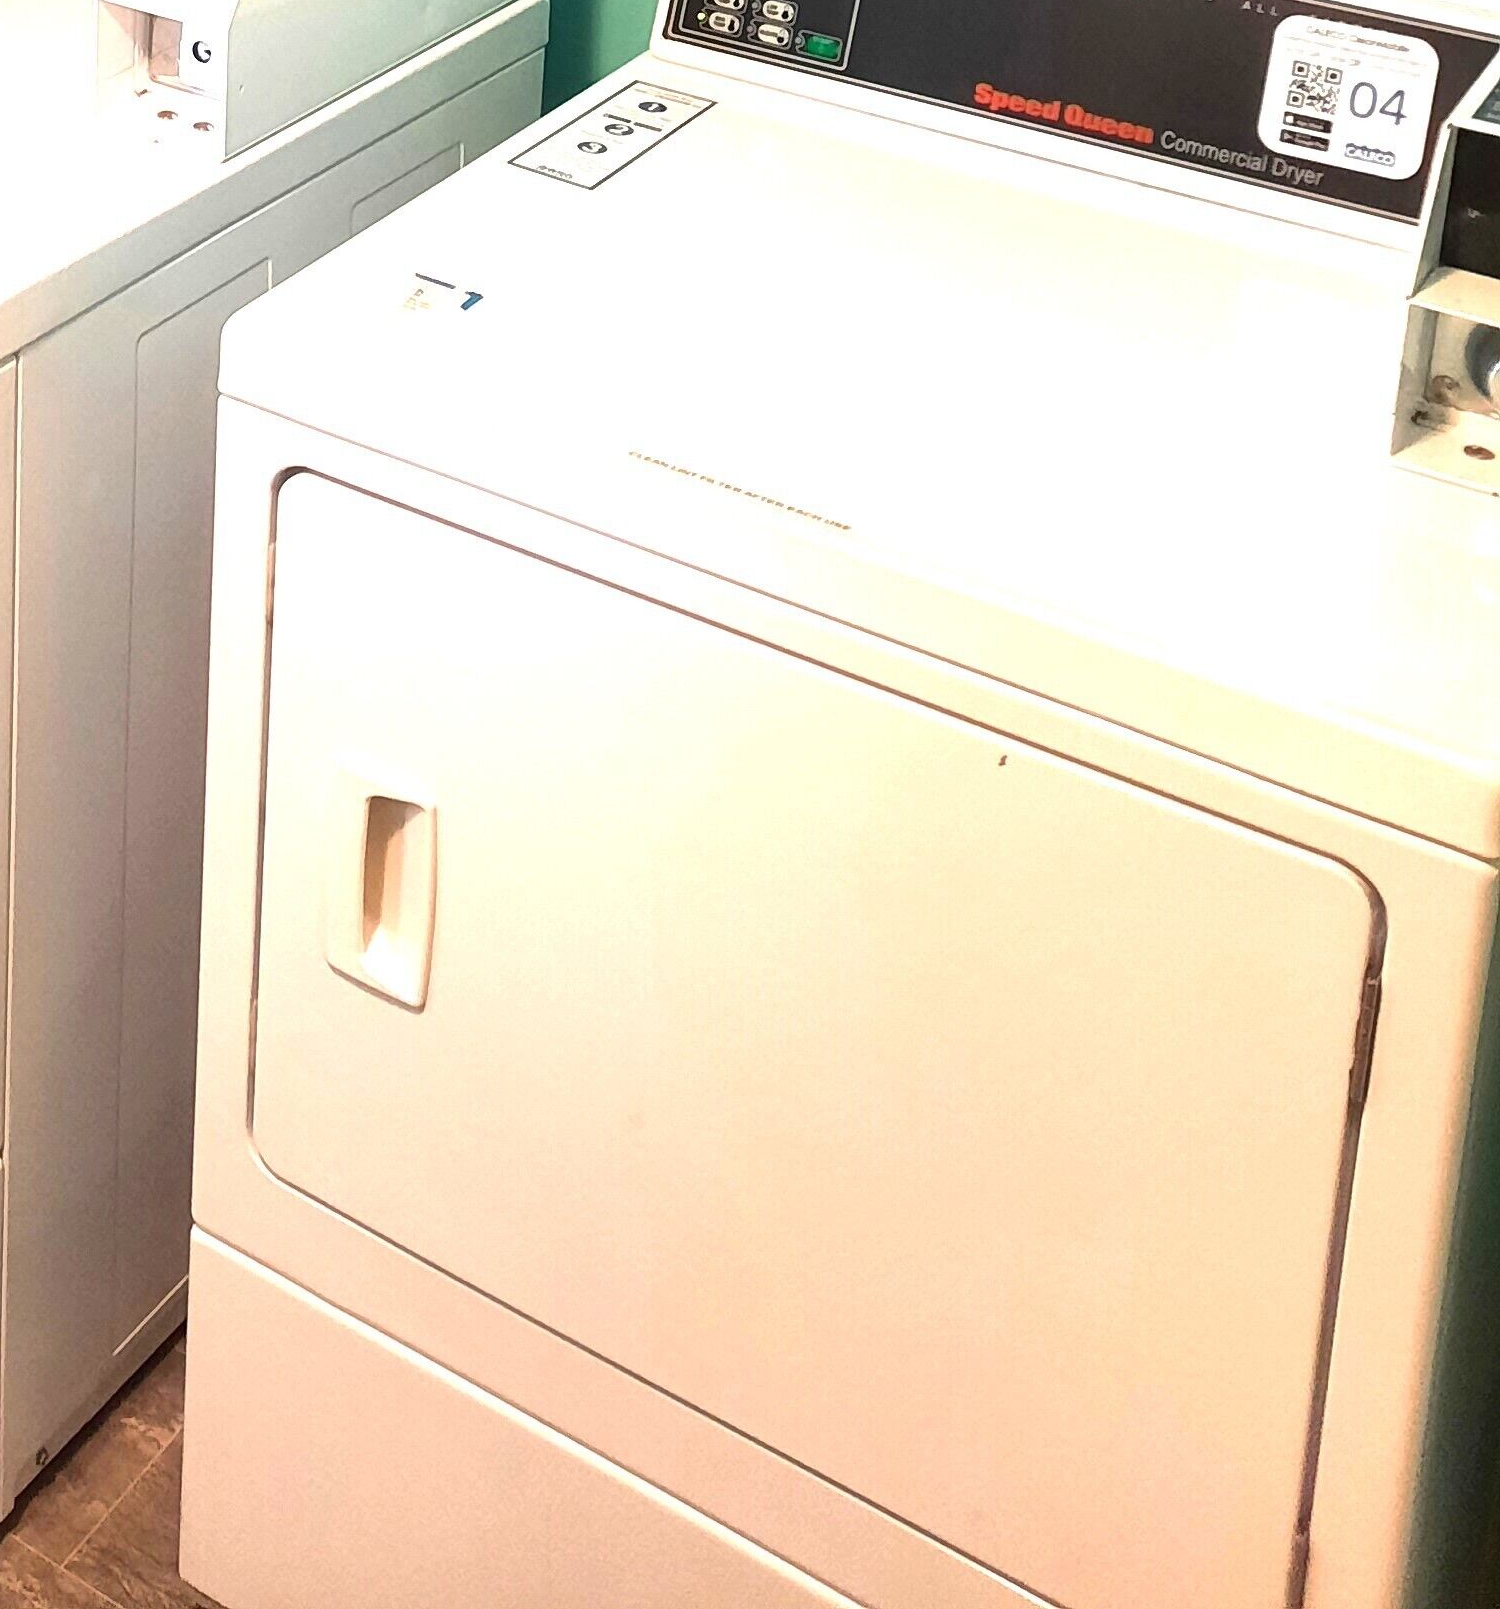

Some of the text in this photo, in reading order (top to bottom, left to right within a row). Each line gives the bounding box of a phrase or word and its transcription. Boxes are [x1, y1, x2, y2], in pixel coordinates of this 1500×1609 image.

[974, 82, 1062, 123] Speed
[1064, 104, 1155, 146] Queen
[1160, 130, 1268, 173] Commercial
[1270, 156, 1325, 190] Dryer
[1350, 81, 1408, 126] 04
